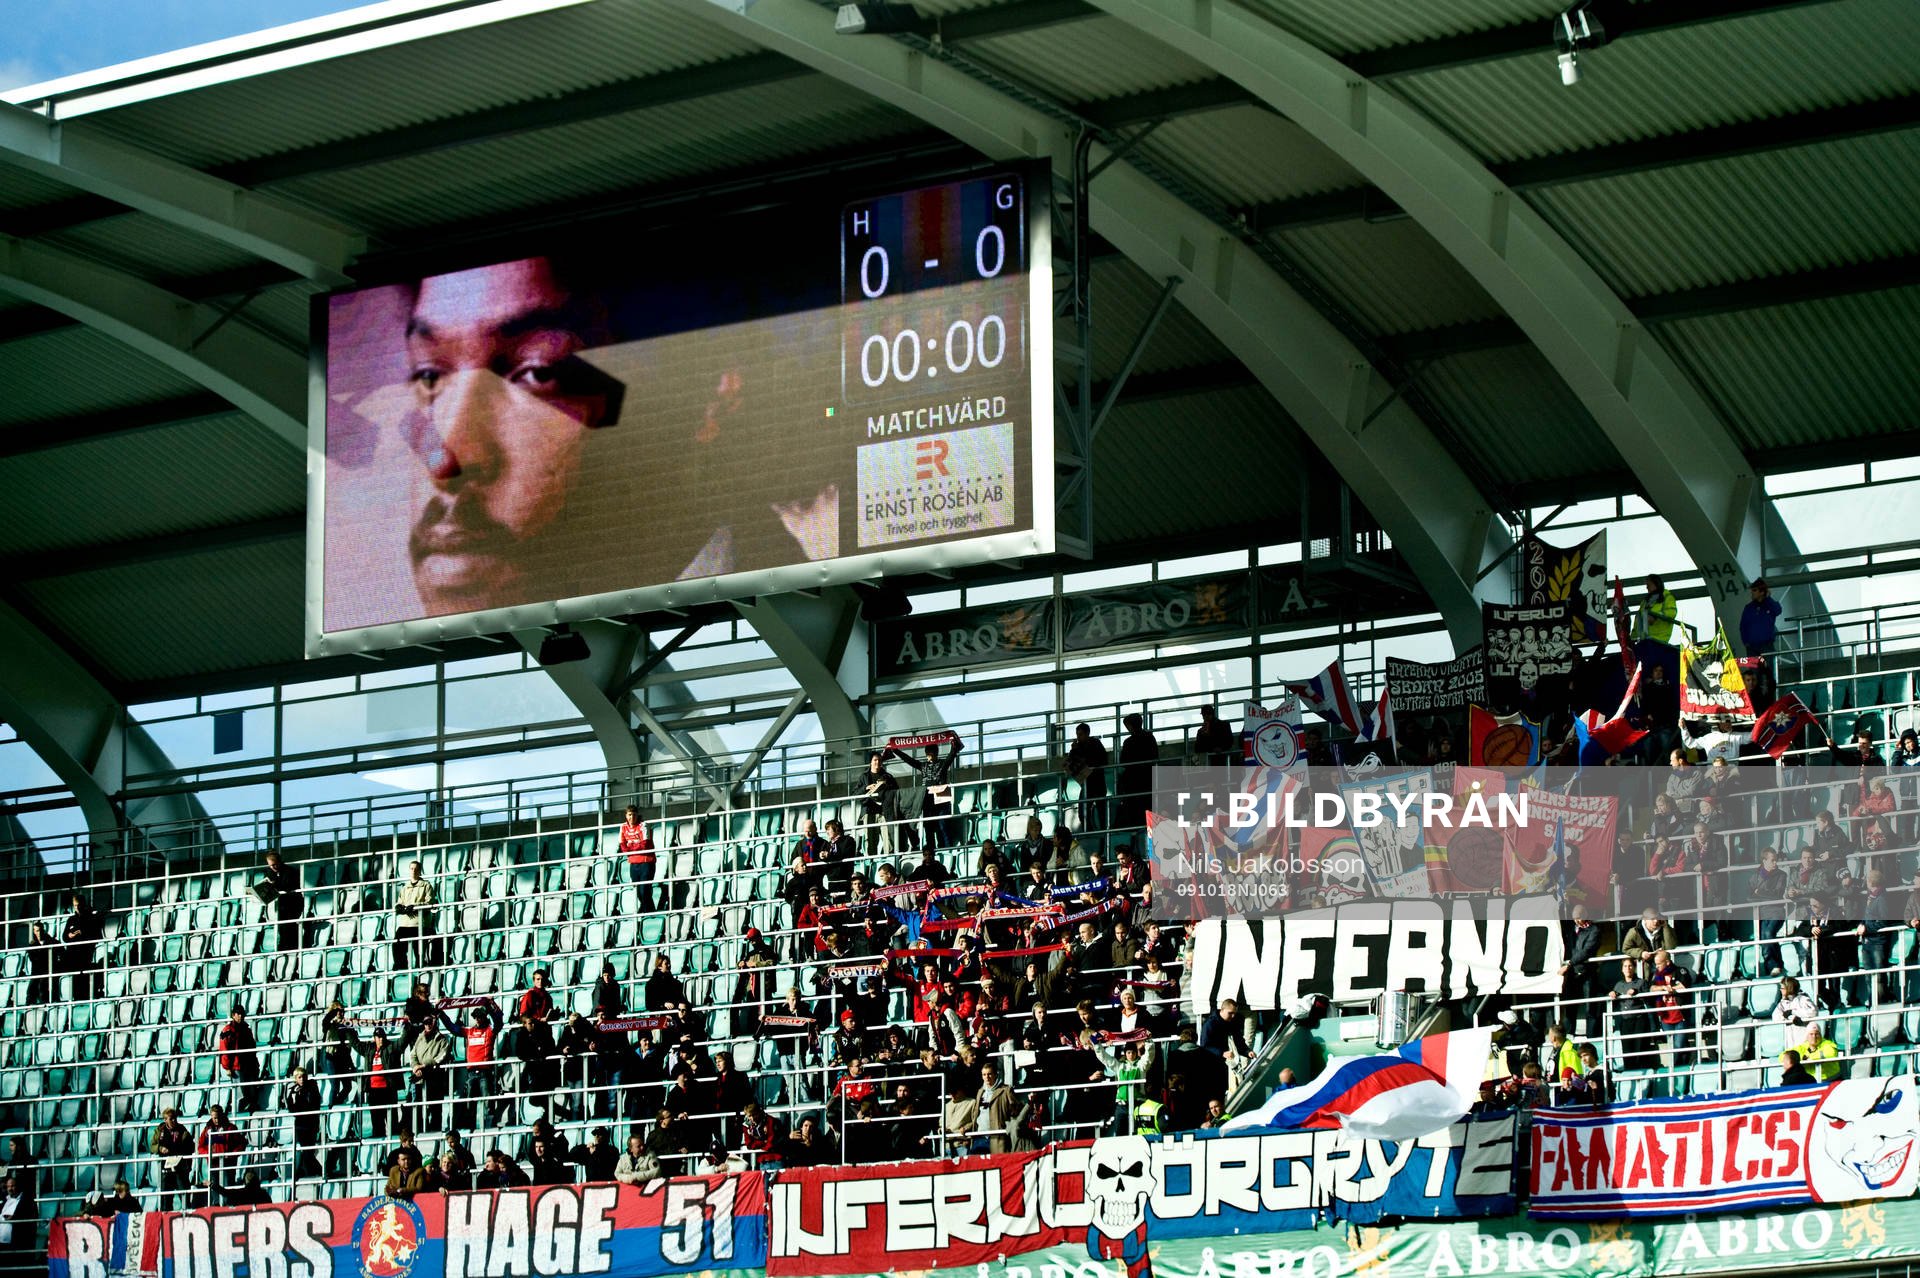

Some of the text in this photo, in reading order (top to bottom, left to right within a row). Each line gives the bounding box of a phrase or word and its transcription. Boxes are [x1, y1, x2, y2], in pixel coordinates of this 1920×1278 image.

[853, 183, 1014, 236] H G
[860, 245, 889, 298] 0
[975, 224, 1005, 279] 0
[860, 314, 1006, 387] 00:00
[867, 395, 1006, 438] MATCHVÄRD
[865, 497, 917, 521] ERNST
[981, 485, 1003, 503] AB
[919, 517, 939, 533] och
[897, 623, 998, 665] ÅBRO
[1085, 598, 1191, 640] ÅBRO
[1528, 787, 1567, 807] MENS
[1543, 823, 1584, 842] SNO
[1192, 897, 1565, 1015] INFERNO
[1148, 1117, 1516, 1218] ÖRGRYTE
[1531, 1110, 1801, 1195] FANATICS
[444, 1181, 617, 1278] HAGE
[1425, 1220, 1581, 1278] ÅBRO
[1673, 1206, 1834, 1260] ÅBRO
